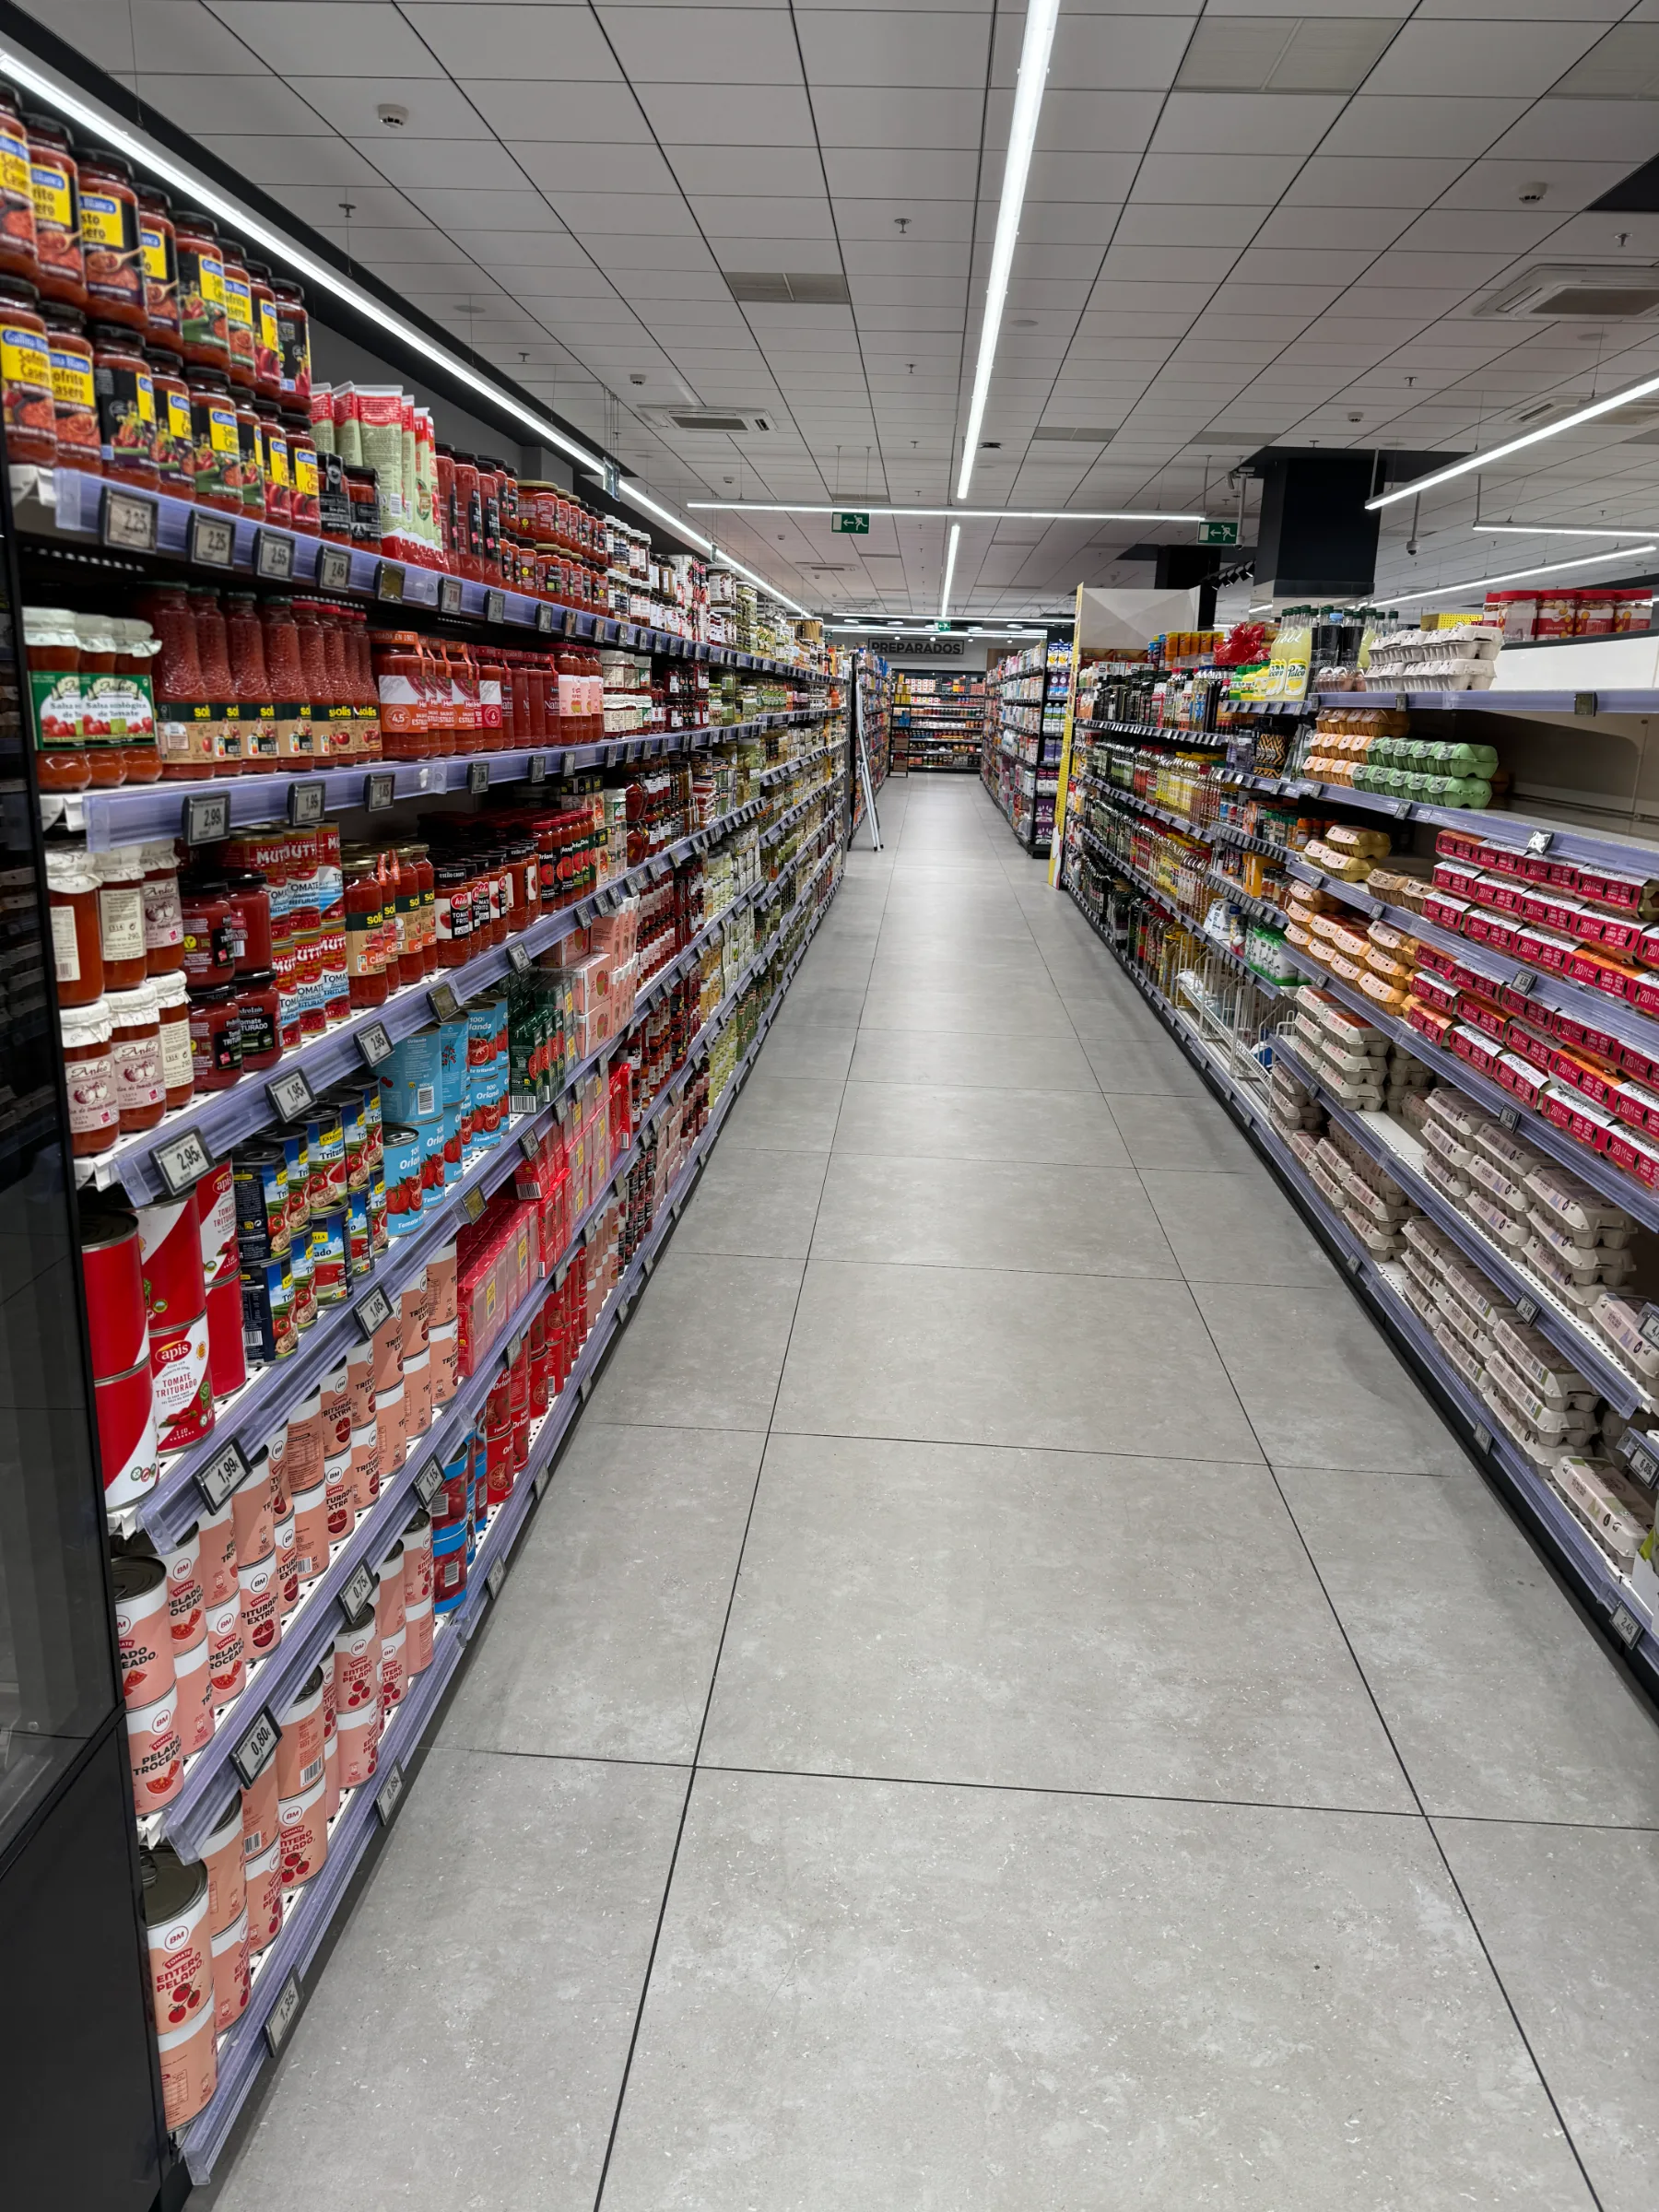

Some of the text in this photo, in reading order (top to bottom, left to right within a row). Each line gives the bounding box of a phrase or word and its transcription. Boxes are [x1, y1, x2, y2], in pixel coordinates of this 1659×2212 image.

[871, 642, 961, 654] PREPARADOS
[121, 1041, 157, 1059] Anko
[71, 1061, 108, 1079] Anko
[161, 1343, 189, 1360] apis
[162, 1371, 192, 1388] TOMATE
[156, 1378, 197, 1398] TRITURADO
[329, 1470, 341, 1480] BM
[328, 1498, 349, 1512] XTRA
[176, 1563, 190, 1575] BM
[173, 1581, 194, 1595] TOMATE
[254, 1577, 266, 1589] BM
[252, 1593, 270, 1607] TOMATE
[220, 1618, 232, 1630] BM
[247, 1608, 275, 1626] EXTRA
[217, 1635, 237, 1650] TOMATE
[121, 1646, 147, 1661] ADO
[122, 1651, 157, 1670] EADO
[156, 1714, 170, 1728] BM
[153, 1733, 173, 1749] TOMATE
[251, 1726, 272, 1756] 0,80€
[142, 1736, 181, 1766] PELADO
[287, 1810, 300, 1820] BM
[281, 1825, 305, 1838] TOMATE
[280, 1836, 313, 1855] ELADO
[170, 1930, 185, 1945] BM
[166, 1948, 194, 1969] TOMATE
[156, 1951, 202, 1983] ENTERO
[156, 1959, 203, 1993] PELADO
